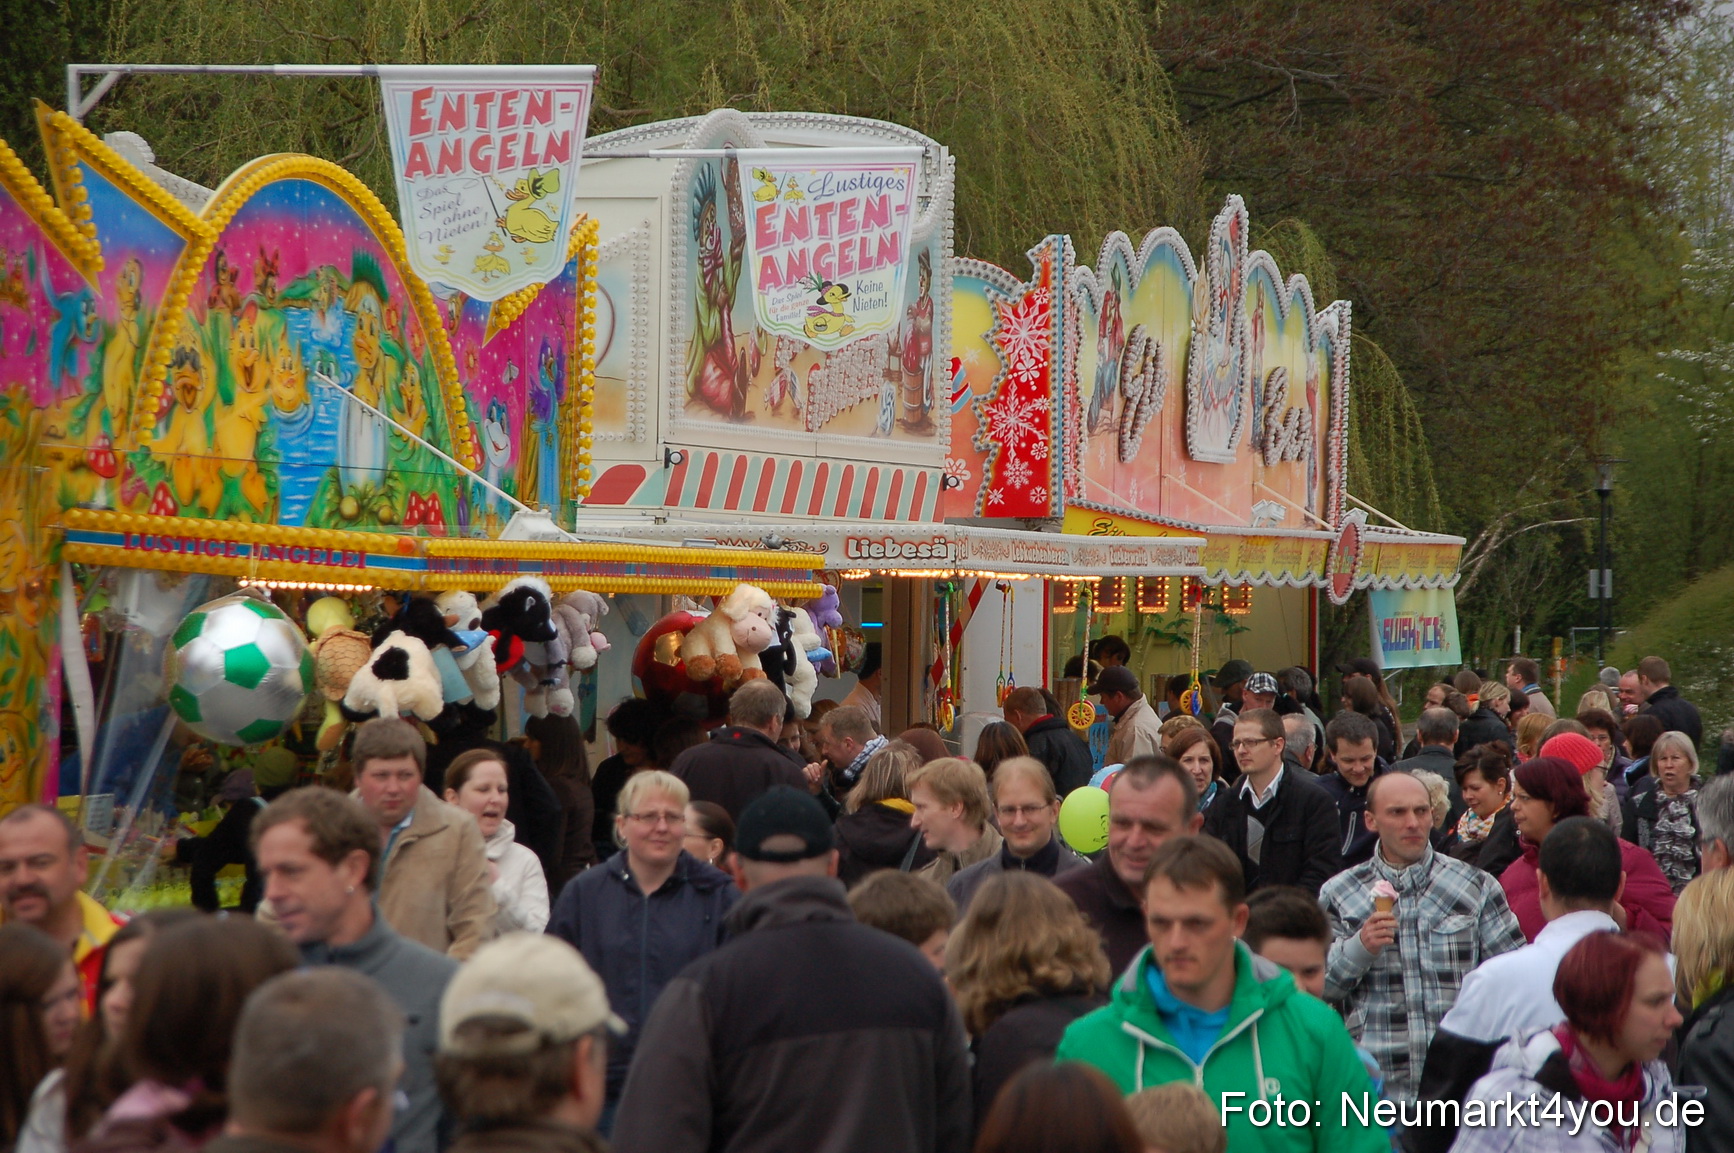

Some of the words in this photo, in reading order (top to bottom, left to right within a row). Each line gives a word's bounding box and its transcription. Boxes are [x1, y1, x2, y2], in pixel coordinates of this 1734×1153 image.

[408, 86, 574, 138] ENTEN-
[403, 130, 573, 183] ANGELN
[807, 171, 906, 201] Lustiges
[419, 192, 463, 220] Spiel
[443, 207, 480, 226] ohne
[418, 211, 489, 244] Nieten!
[755, 193, 909, 254] ENTEN-
[757, 231, 903, 295] ANGELN
[852, 292, 889, 314] Nieten!
[856, 279, 884, 295] Keine
[122, 531, 240, 558] LUSTIGE
[247, 541, 367, 569] ANGELEI
[1383, 617, 1417, 651] SLUSH
